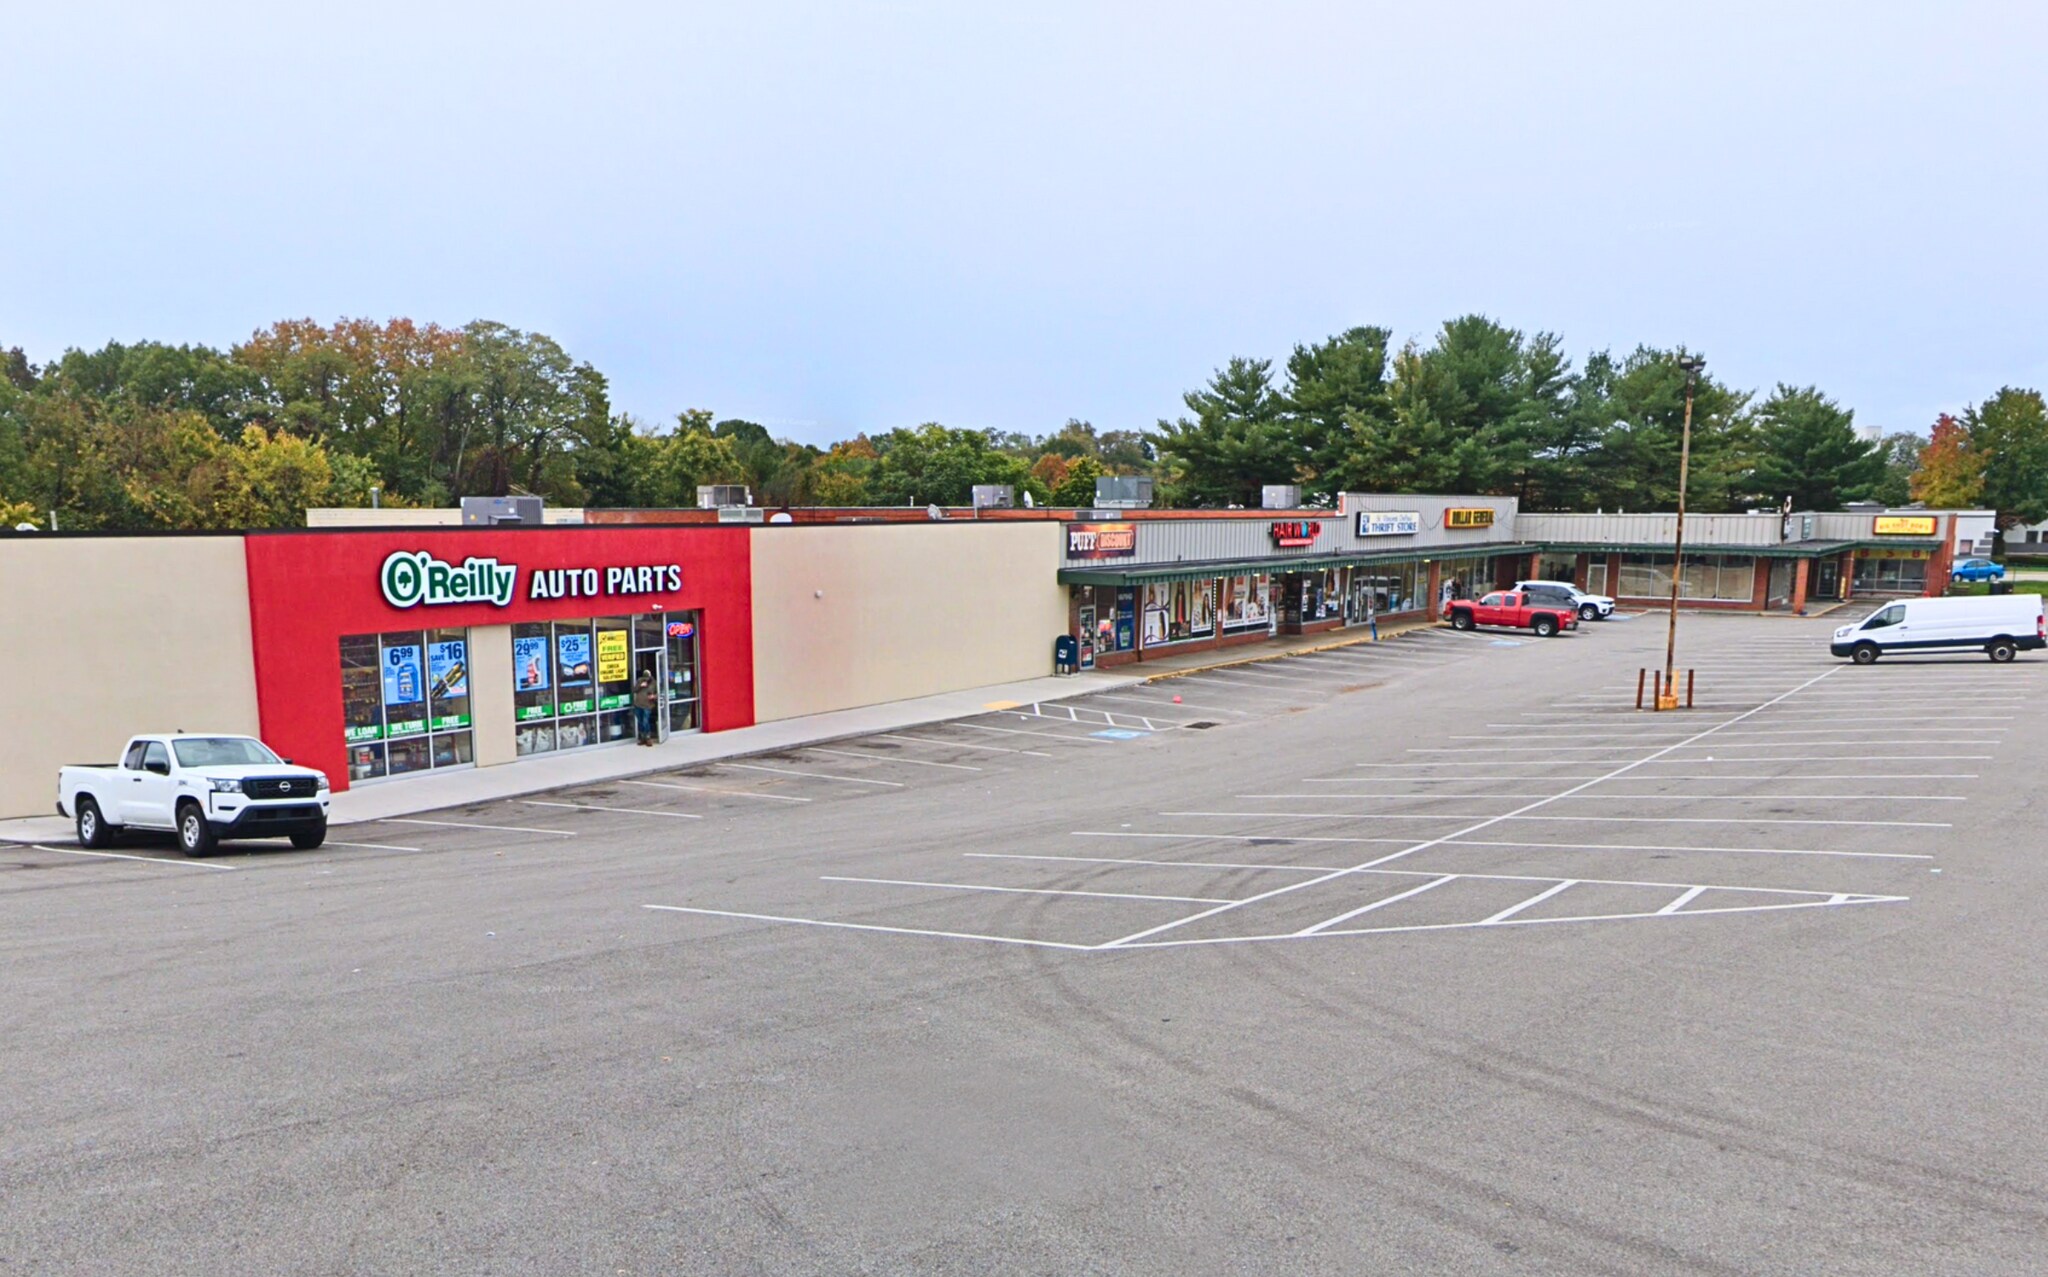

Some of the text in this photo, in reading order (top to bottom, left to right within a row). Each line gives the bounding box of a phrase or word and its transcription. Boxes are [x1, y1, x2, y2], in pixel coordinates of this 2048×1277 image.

[1273, 522, 1291, 538] HAIR
[1371, 522, 1416, 532] THRIFT STORE
[1070, 532, 1097, 551] PUFF
[386, 555, 681, 603] O'Reilly AUTO PARTS
[668, 623, 692, 636] OPEN
[561, 639, 579, 651] $25
[440, 643, 462, 660] $16
[526, 706, 542, 714] FREE
[573, 700, 588, 708] FREE
[442, 715, 459, 725] FREE
[358, 726, 378, 735] LOAN
